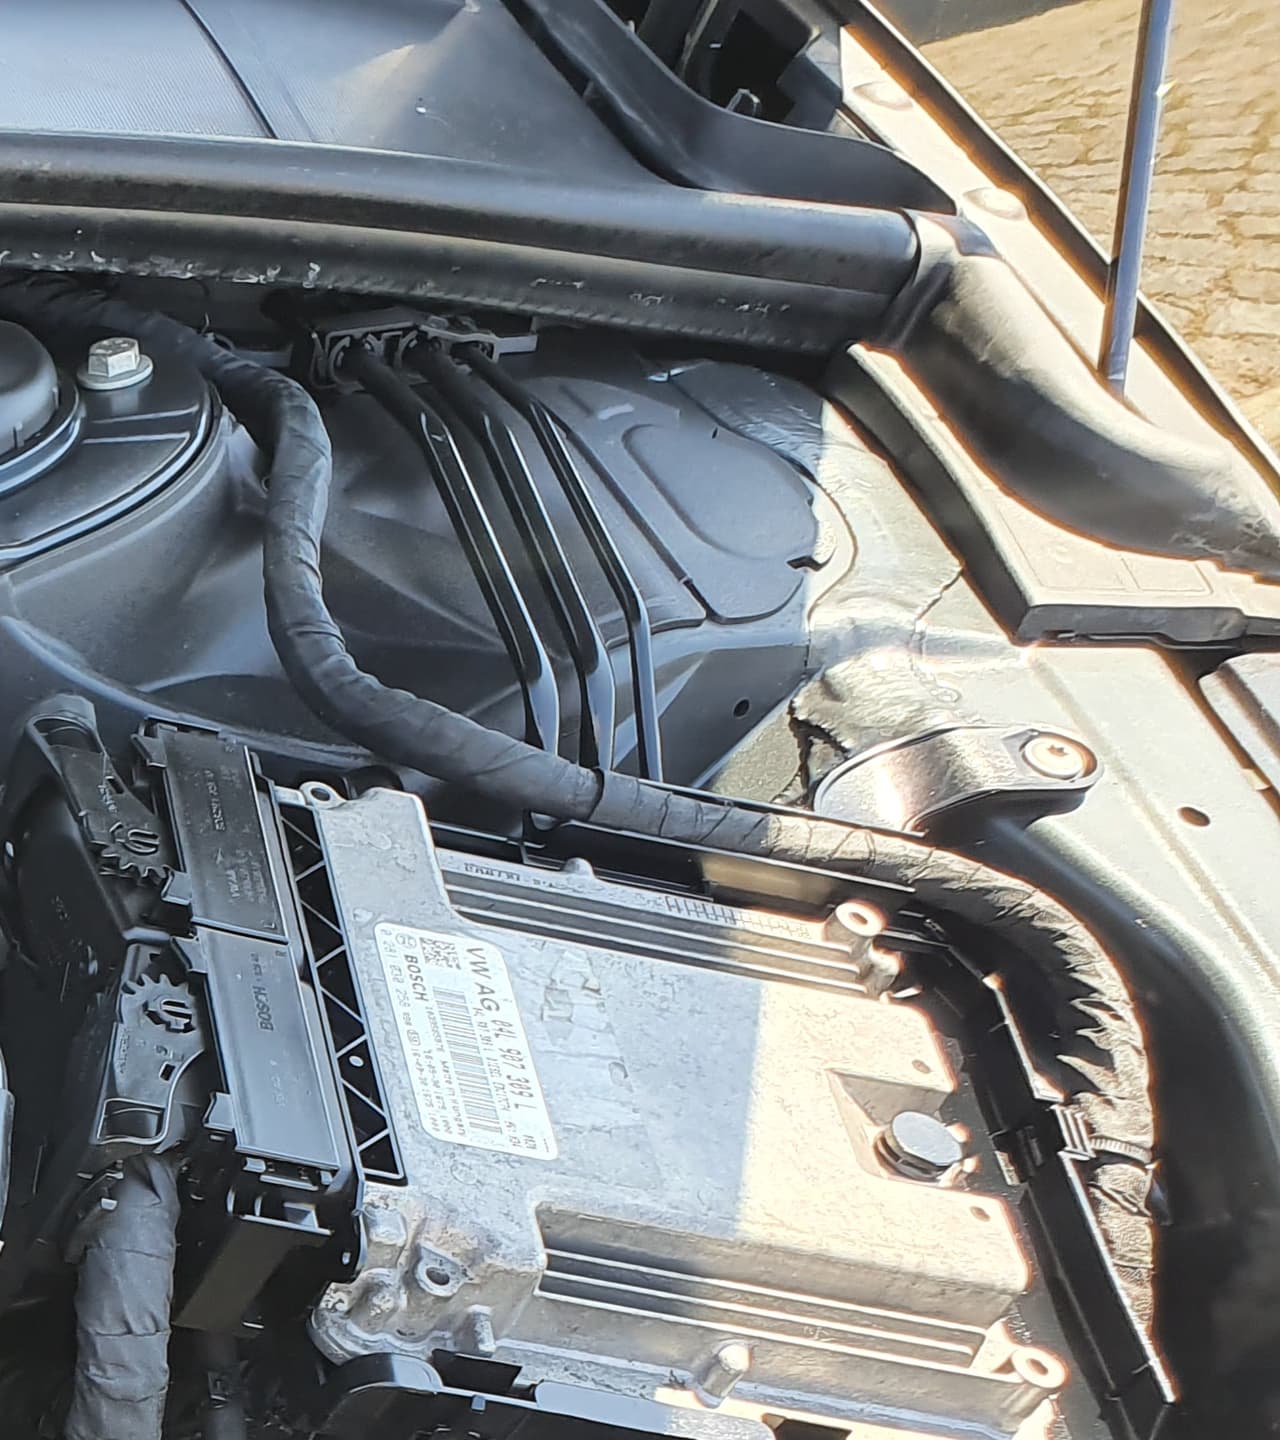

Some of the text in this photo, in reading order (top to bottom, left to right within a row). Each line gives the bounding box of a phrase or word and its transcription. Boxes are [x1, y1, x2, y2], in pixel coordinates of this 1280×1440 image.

[403, 953, 429, 1002] BOSCH
[464, 945, 491, 980] VW
[253, 986, 274, 1031] BOSCH
[474, 982, 501, 1014] AG
[490, 1018, 517, 1042] 04L
[497, 1045, 525, 1070] 907
[438, 1059, 453, 1085] Made
[447, 1097, 466, 1136] Hungary
[513, 1101, 537, 1113] L
